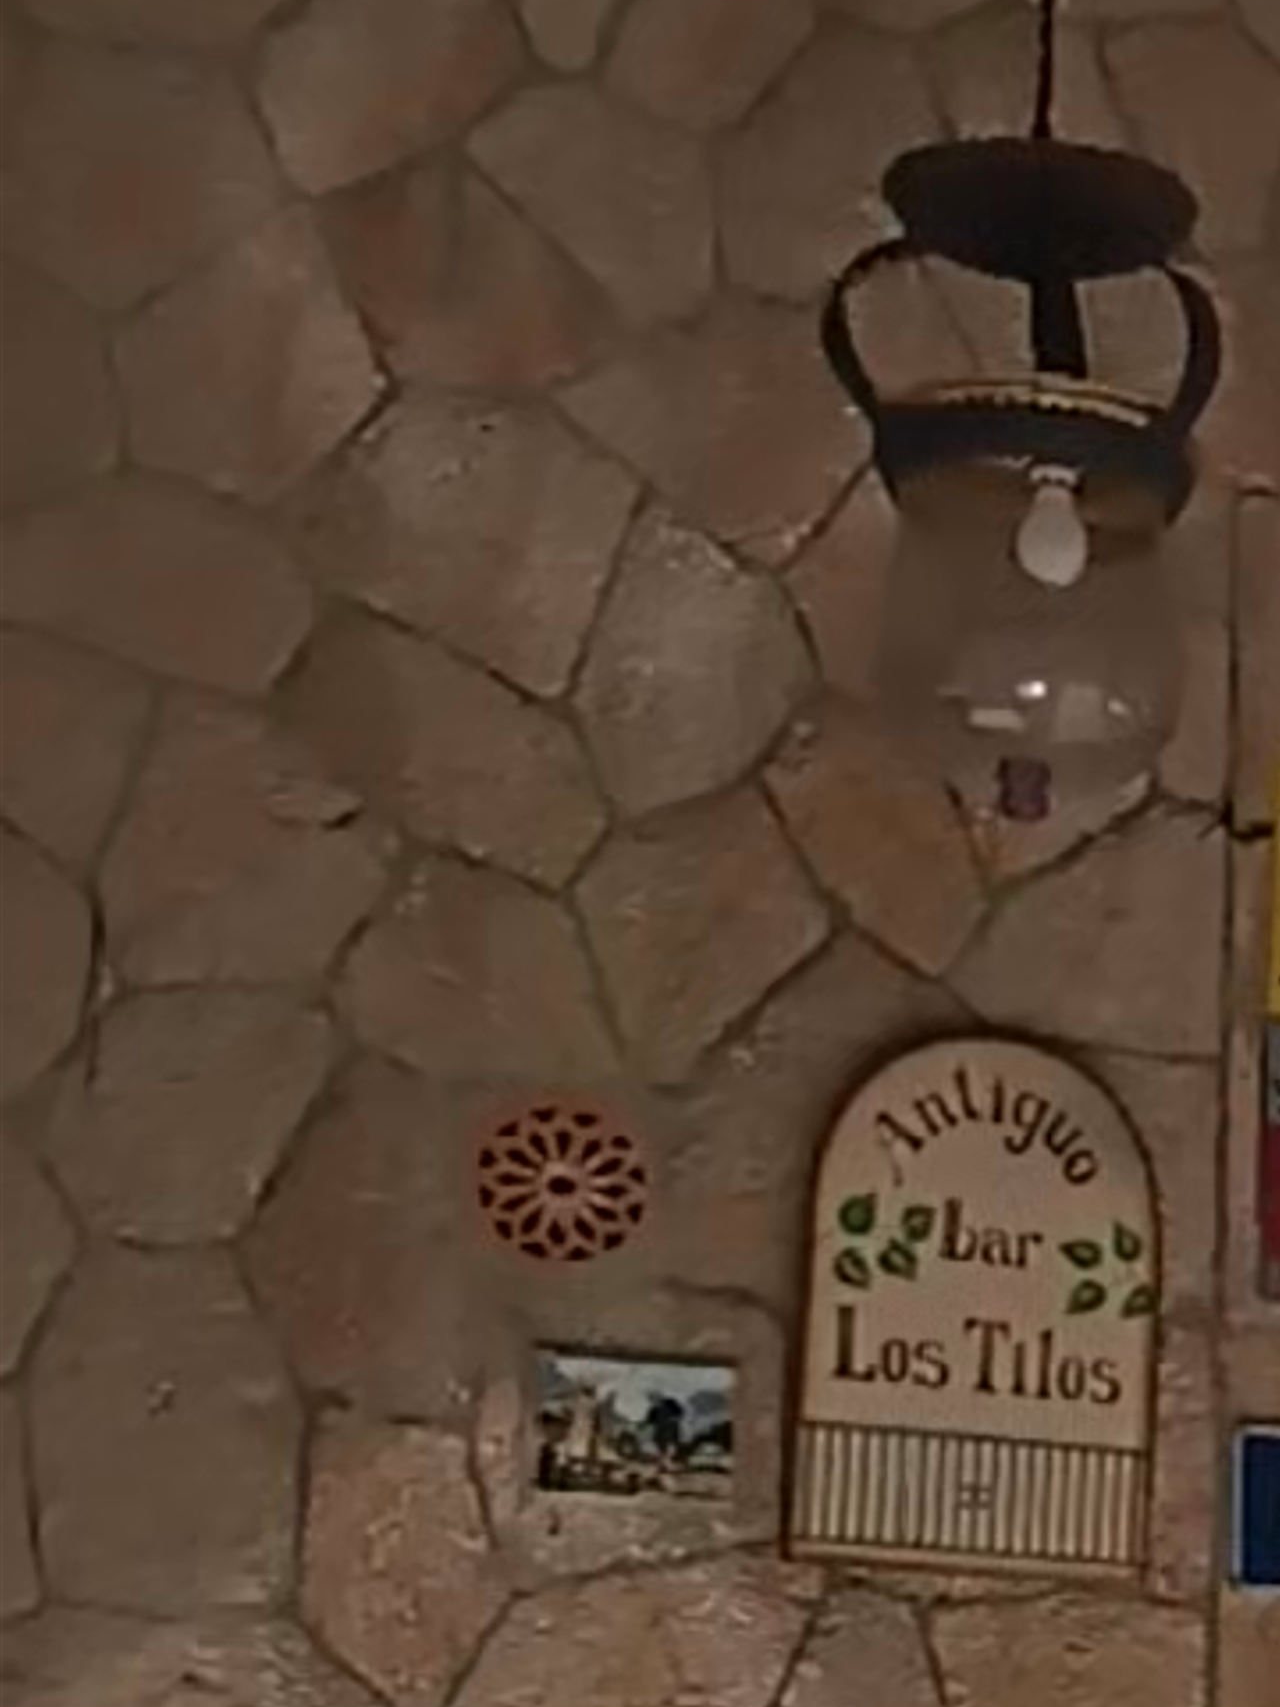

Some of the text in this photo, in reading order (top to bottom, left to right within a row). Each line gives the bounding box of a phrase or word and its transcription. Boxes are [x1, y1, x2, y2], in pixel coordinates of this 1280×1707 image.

[875, 1060, 1099, 1186] Antiguo
[832, 1303, 1122, 1405] Los Tilos
